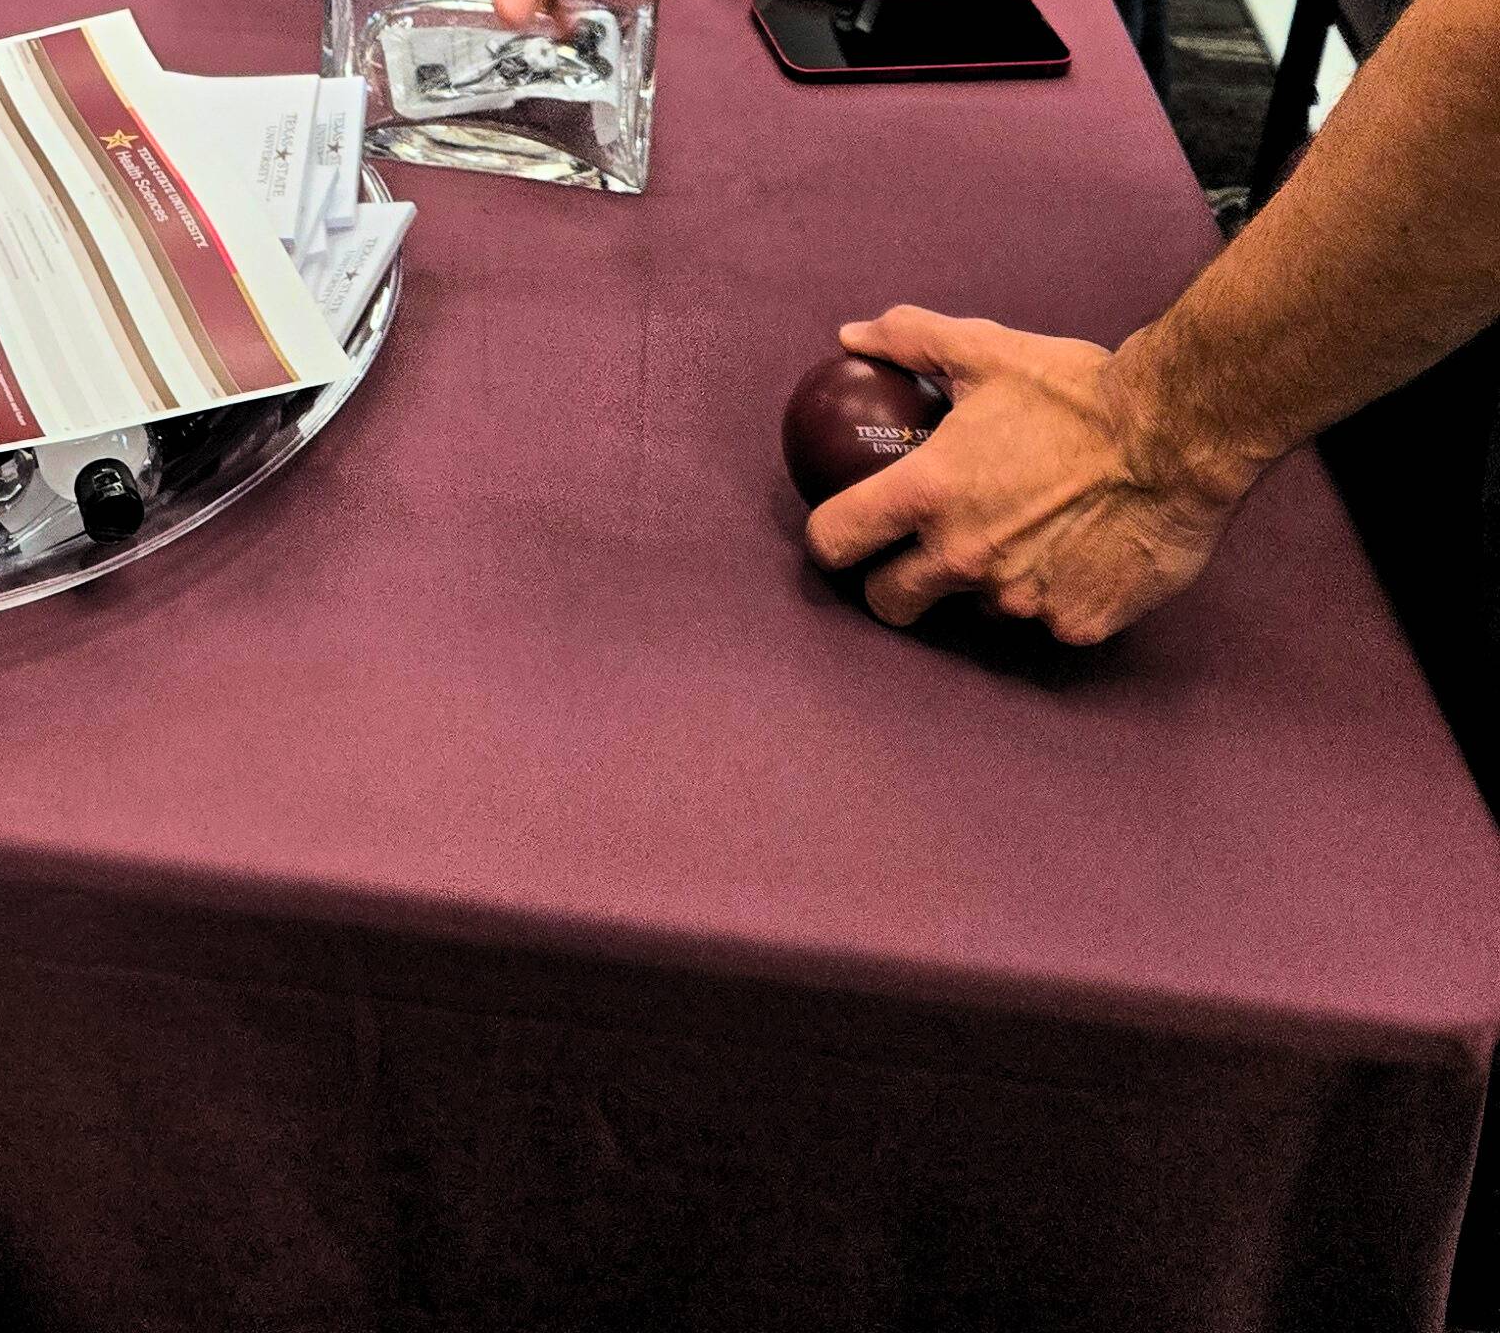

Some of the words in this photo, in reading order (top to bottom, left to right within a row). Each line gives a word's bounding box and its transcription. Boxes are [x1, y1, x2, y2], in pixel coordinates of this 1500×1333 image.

[283, 113, 298, 152] TEXAS
[136, 145, 161, 174] TEXAS
[152, 167, 176, 195] STATE
[257, 125, 278, 185] UNIVERSITY
[114, 150, 145, 181] Health
[134, 178, 169, 223] Sciences
[272, 160, 290, 198] STATE
[855, 426, 901, 438] TEXAS
